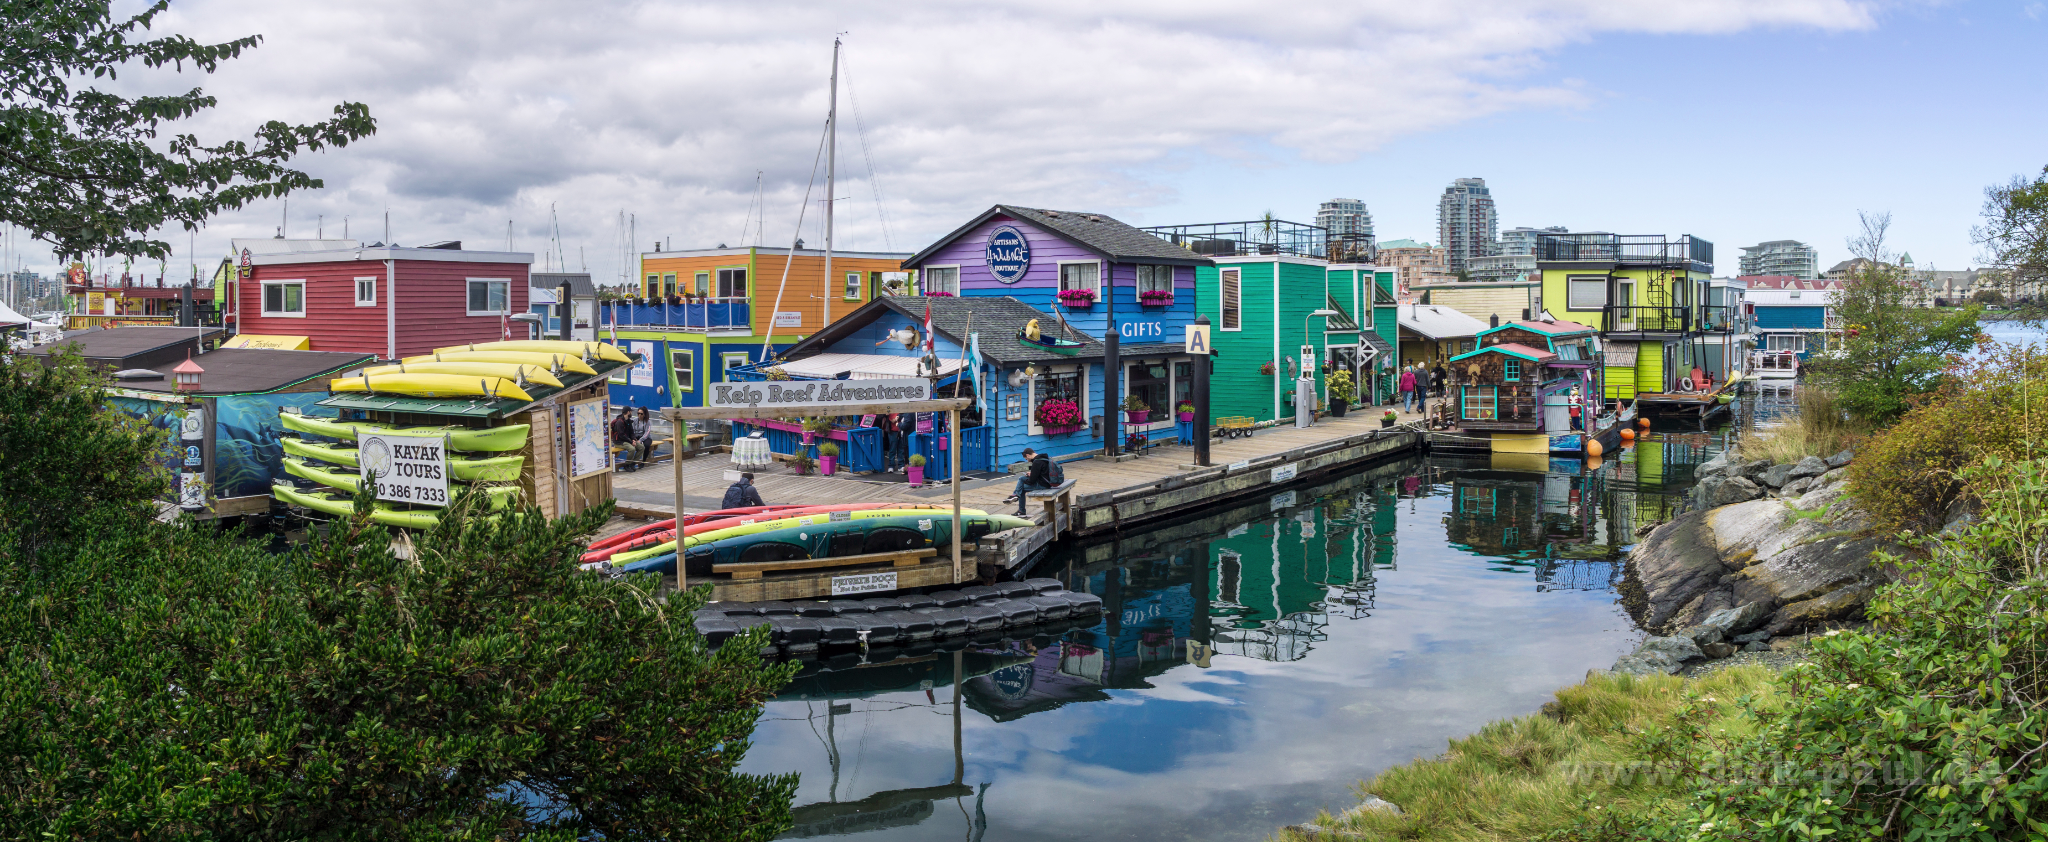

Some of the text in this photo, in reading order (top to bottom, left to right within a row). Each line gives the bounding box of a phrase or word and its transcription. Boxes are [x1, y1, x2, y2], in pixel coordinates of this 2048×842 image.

[557, 290, 563, 303] B
[1121, 321, 1162, 337] GIFTS
[1190, 330, 1206, 352] A
[715, 383, 925, 407] Kelp Reef Adventures
[393, 444, 441, 461] KAYAK
[394, 461, 442, 480] TOURS
[389, 483, 411, 499] 386
[414, 486, 446, 502] 7333
[832, 574, 897, 587] PRIVATE DOCK
